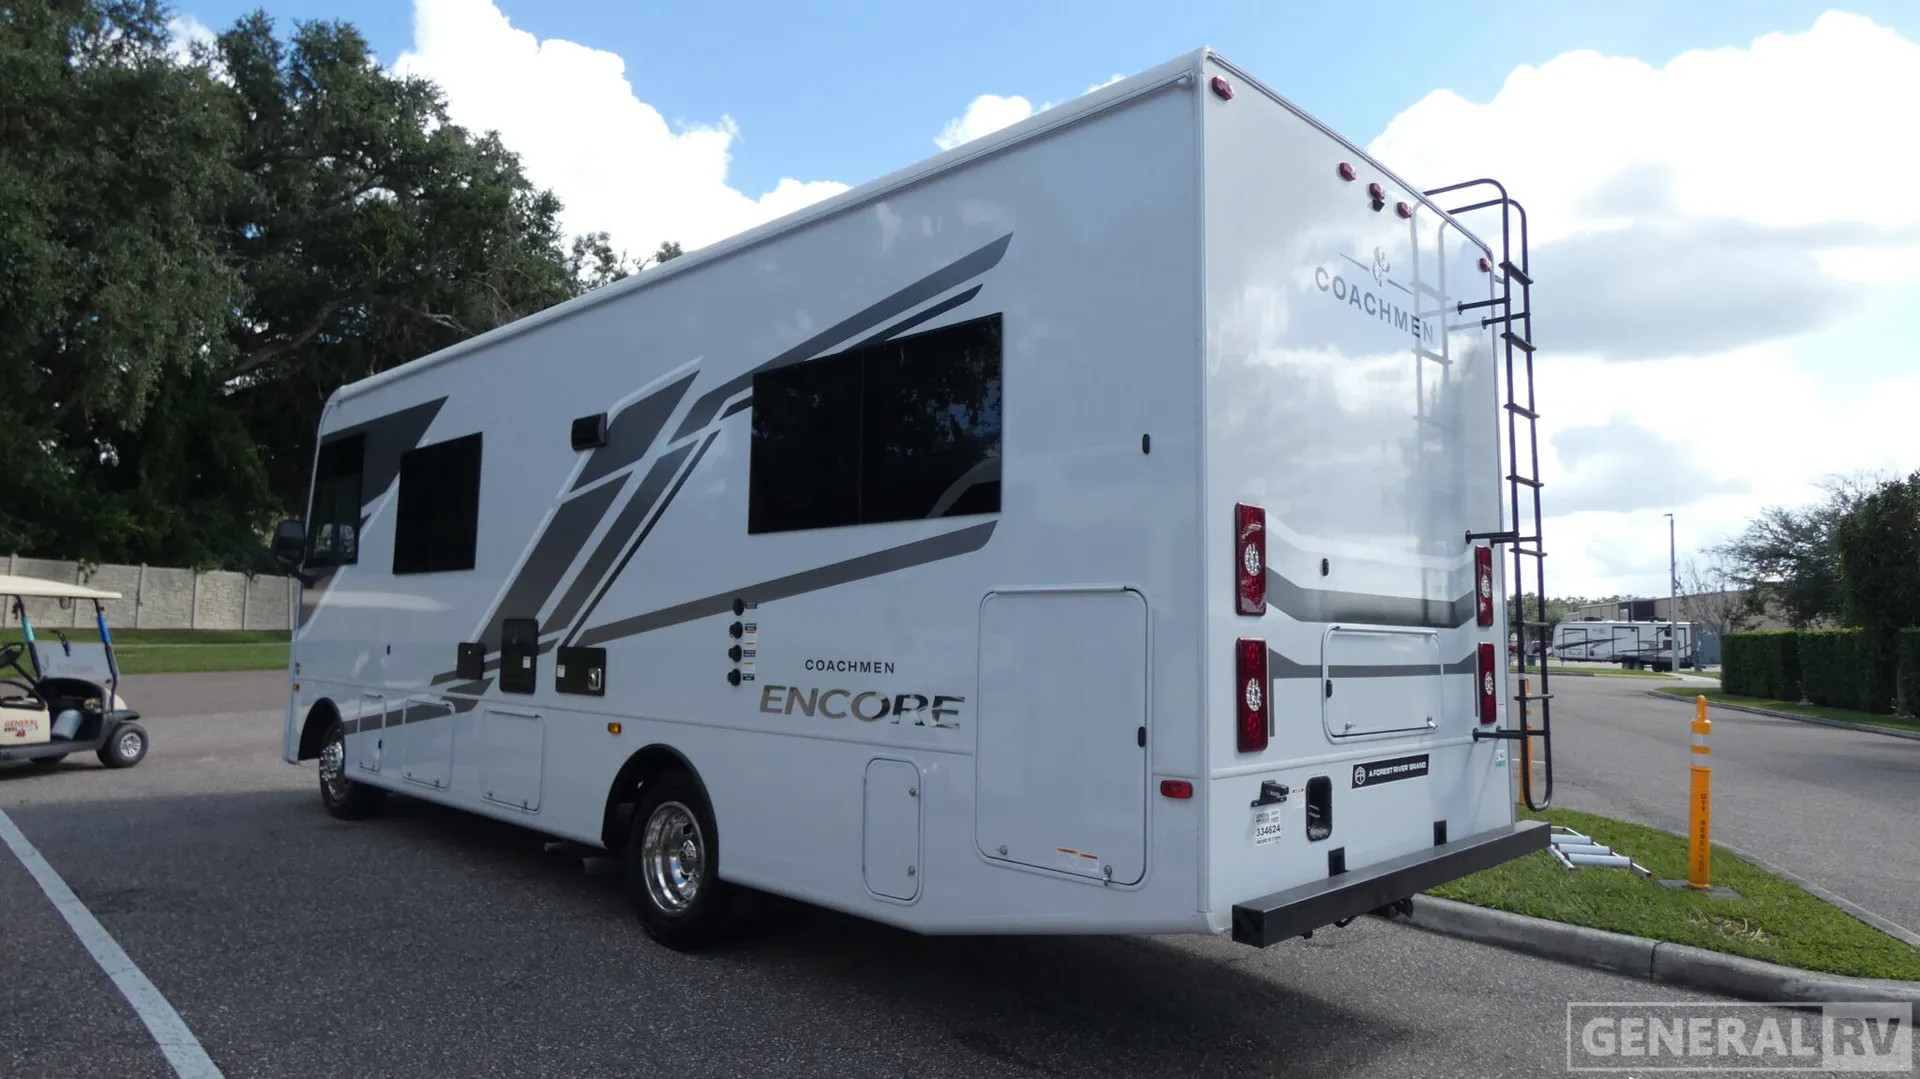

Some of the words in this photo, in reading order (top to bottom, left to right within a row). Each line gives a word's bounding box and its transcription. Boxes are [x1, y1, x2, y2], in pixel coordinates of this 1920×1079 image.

[1314, 266, 1434, 344] COACHMEN
[804, 659, 895, 675] COACHMEN
[759, 684, 966, 730] ENCORE
[1373, 766, 1393, 776] FOREST
[1393, 764, 1408, 773] RIVER
[1409, 761, 1427, 770] BRAND
[1256, 824, 1281, 837] 334624
